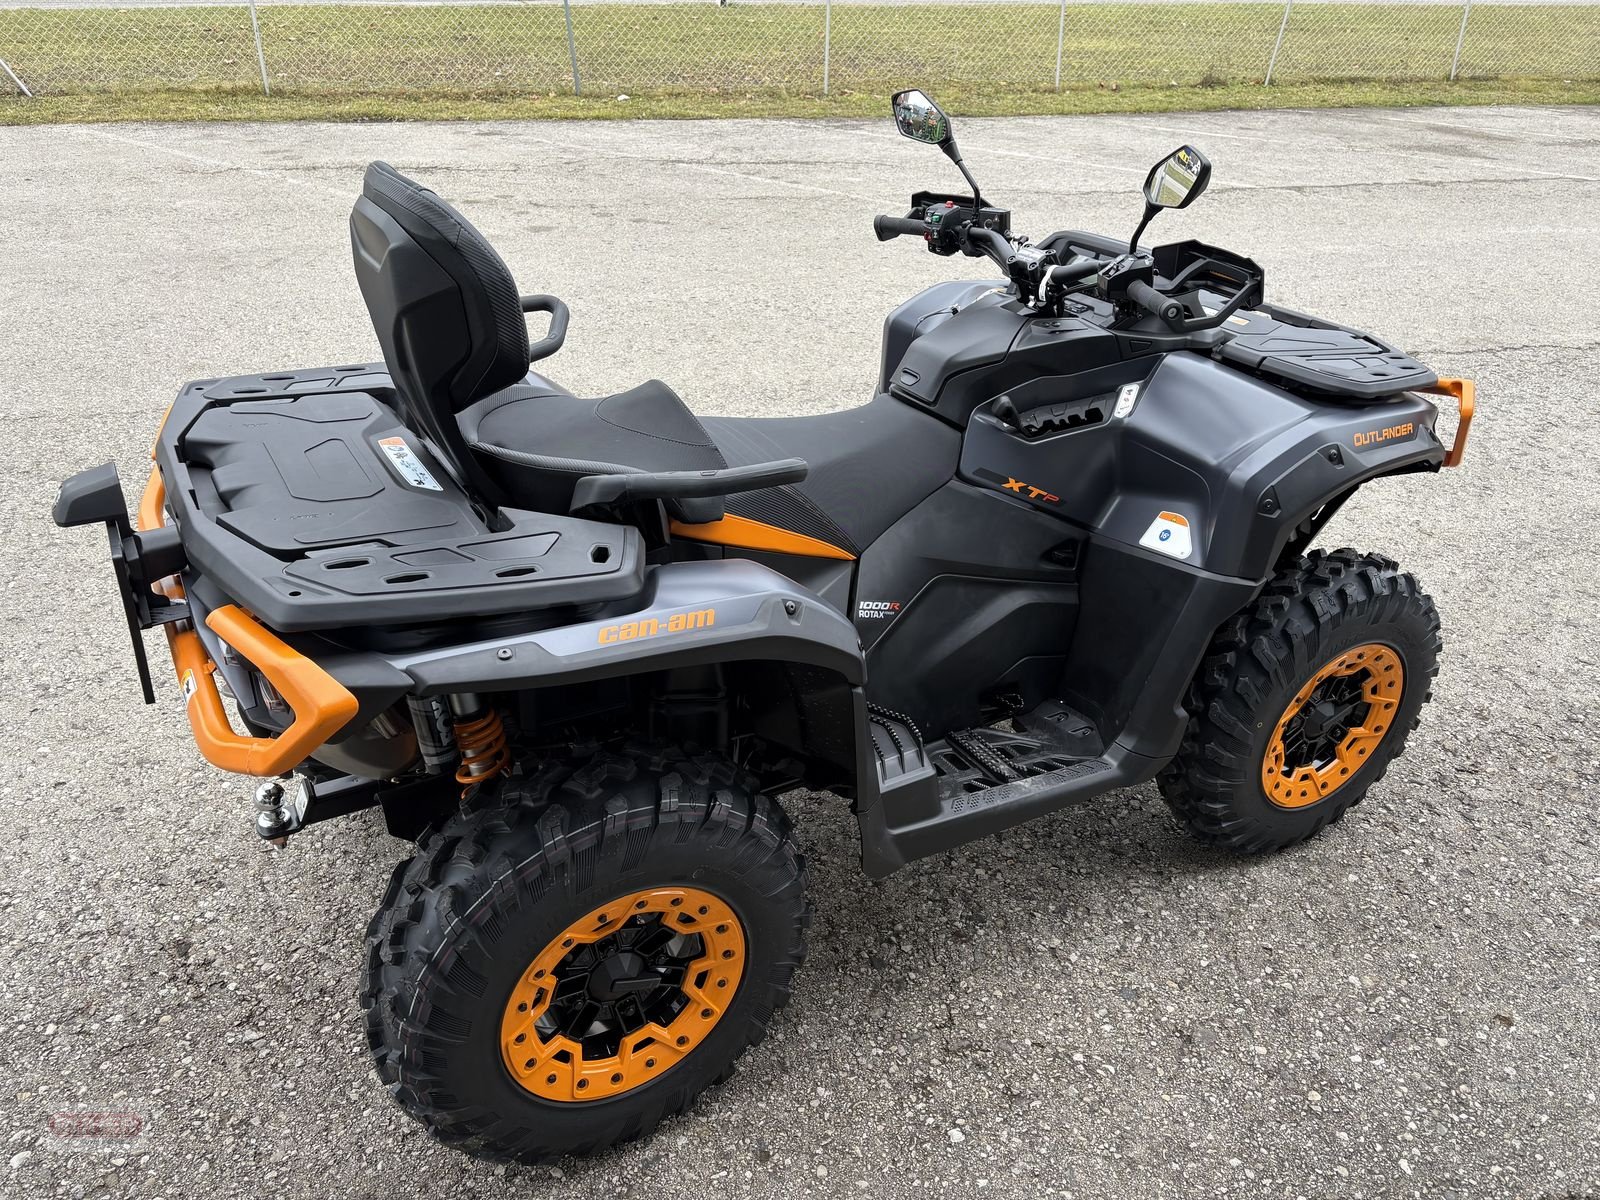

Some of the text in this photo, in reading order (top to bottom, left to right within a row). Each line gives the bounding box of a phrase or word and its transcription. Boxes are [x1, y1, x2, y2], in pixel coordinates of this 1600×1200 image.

[1001, 477, 1060, 502] XTP
[859, 601, 900, 610] 1000R
[858, 610, 884, 619] ROTAX
